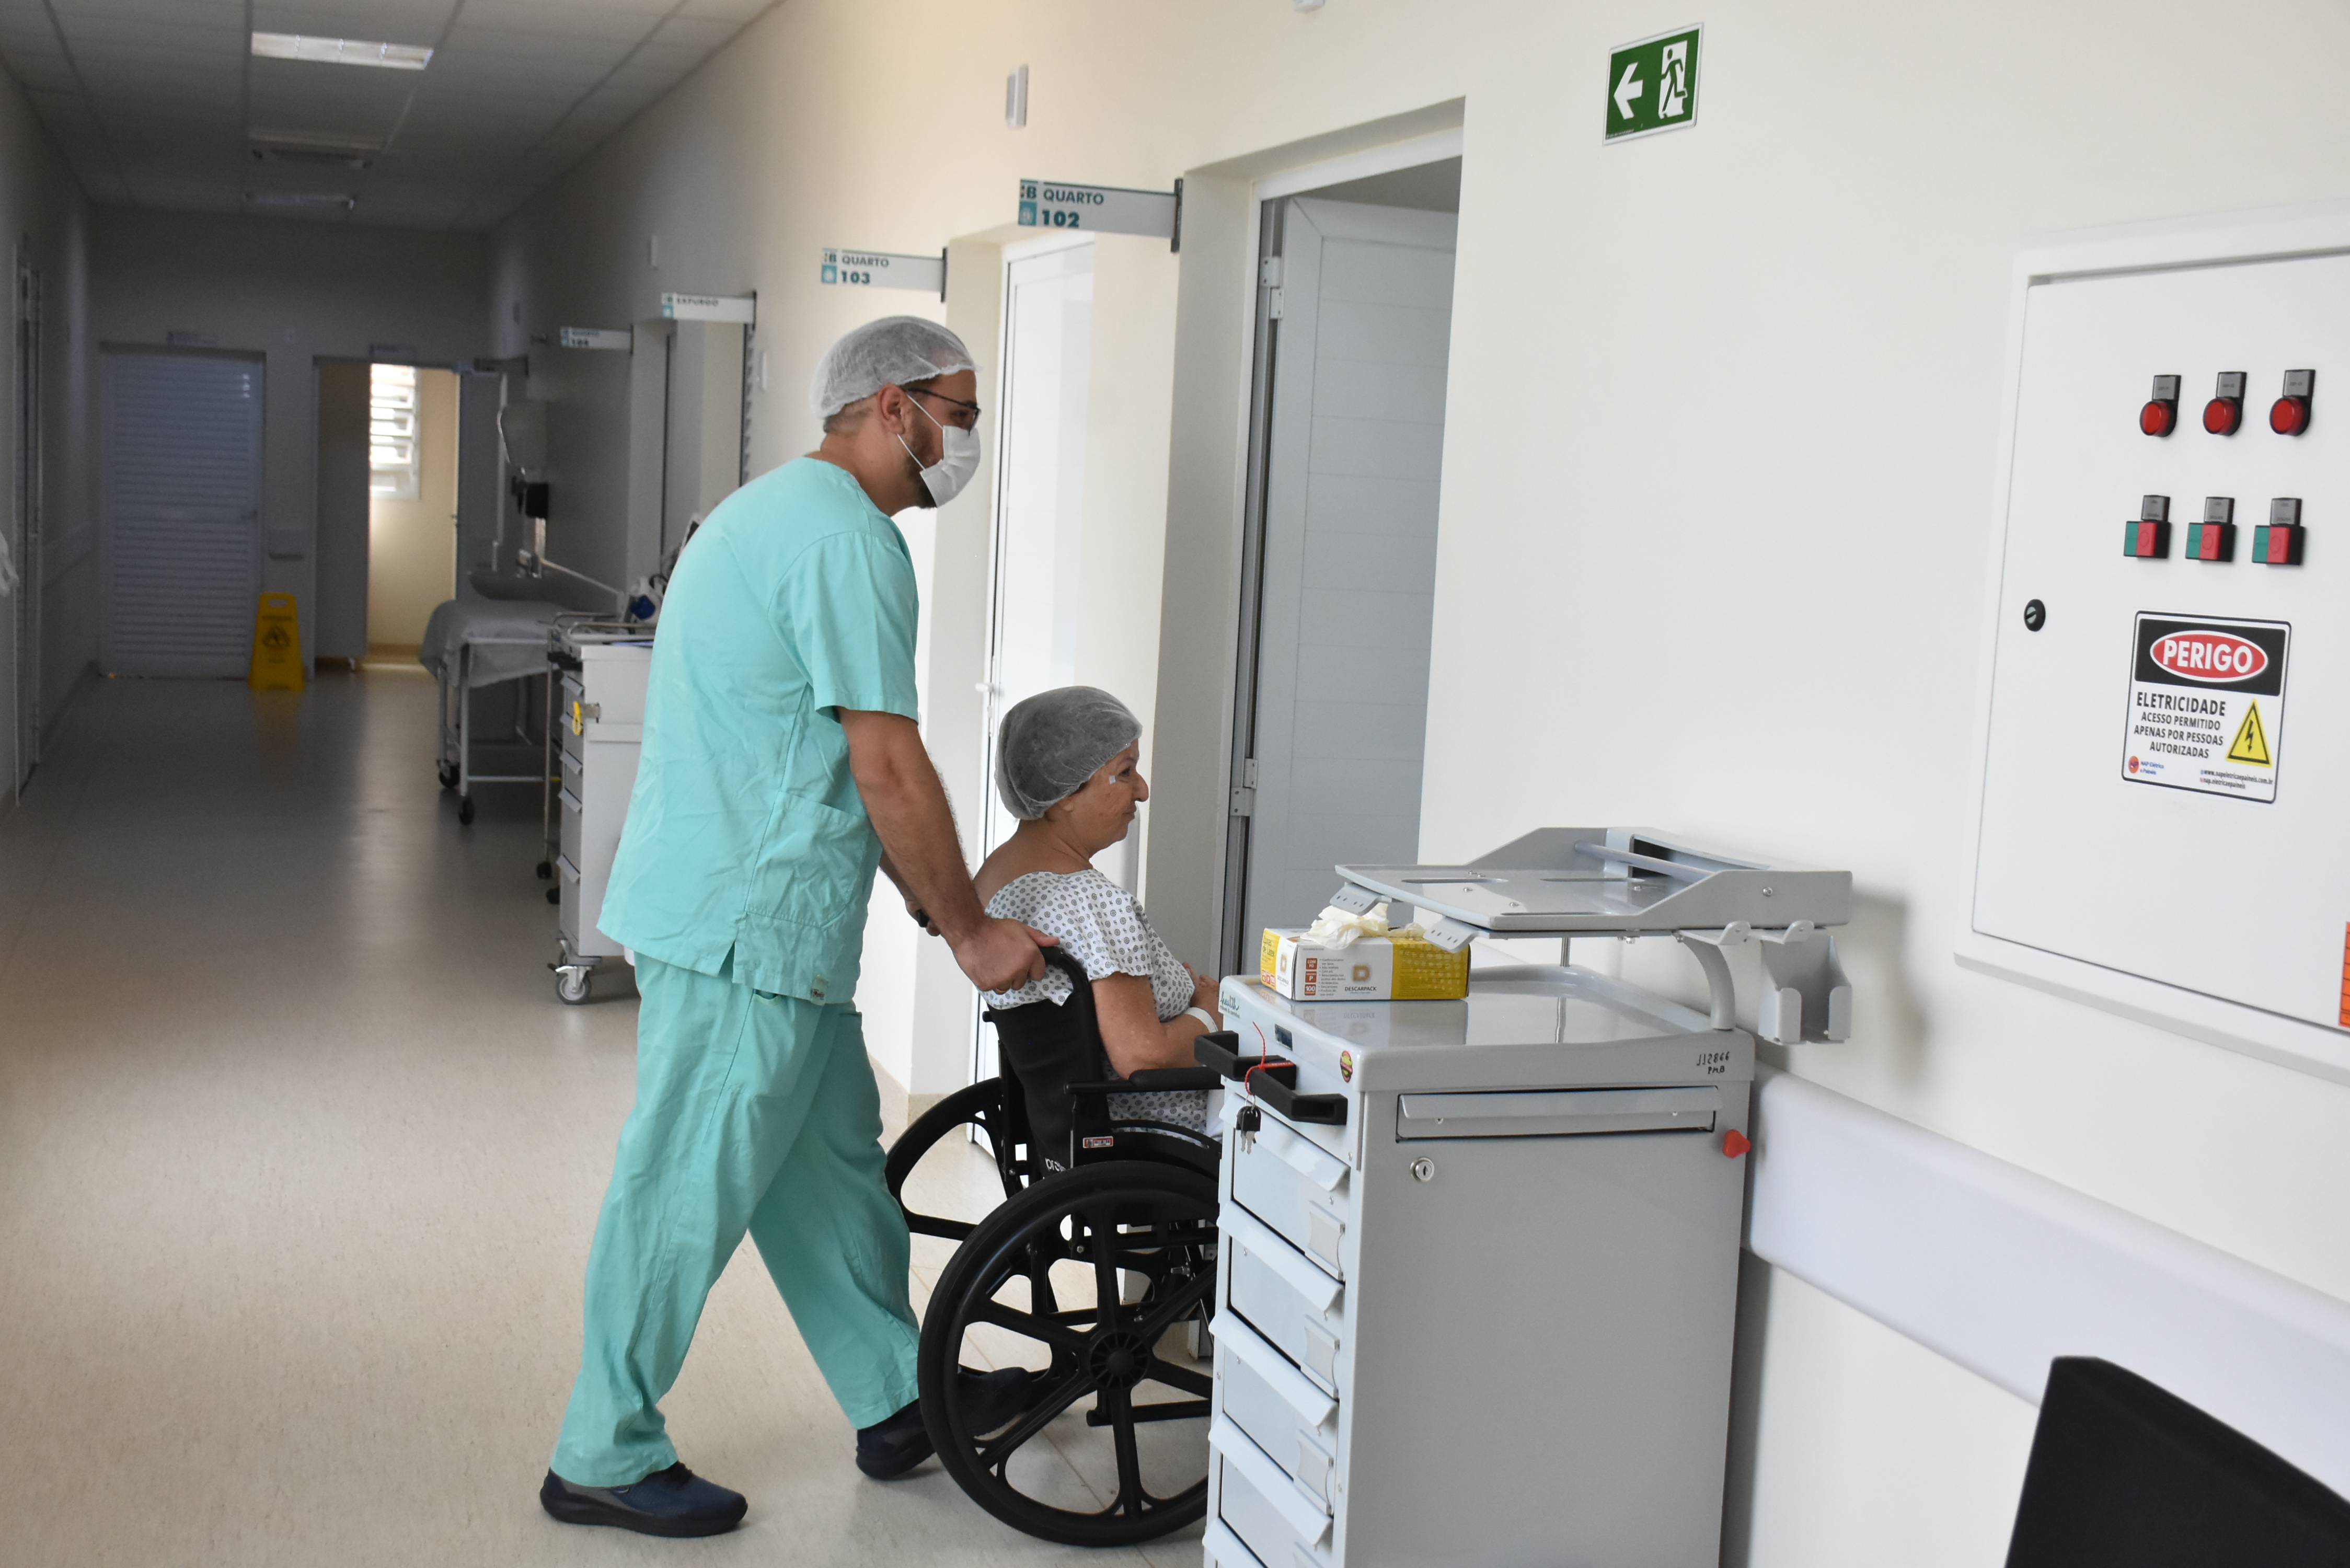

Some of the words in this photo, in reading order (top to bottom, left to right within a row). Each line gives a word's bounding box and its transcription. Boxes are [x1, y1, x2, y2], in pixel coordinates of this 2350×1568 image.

[1044, 189, 1104, 205] QUARTO
[1042, 210, 1079, 228] 102
[842, 255, 889, 268] QUARTO
[842, 270, 870, 284] 103
[2163, 639, 2252, 673] PERIGO
[2137, 691, 2226, 716] ELETRICIDADE
[2141, 711, 2172, 725] ACESSO
[2174, 716, 2220, 731] PERMITIDO
[2134, 725, 2165, 738] APENAS
[2168, 729, 2184, 741] POR
[2186, 732, 2224, 746] PESSOAS
[2150, 741, 2209, 759] AUTORIZADAS
